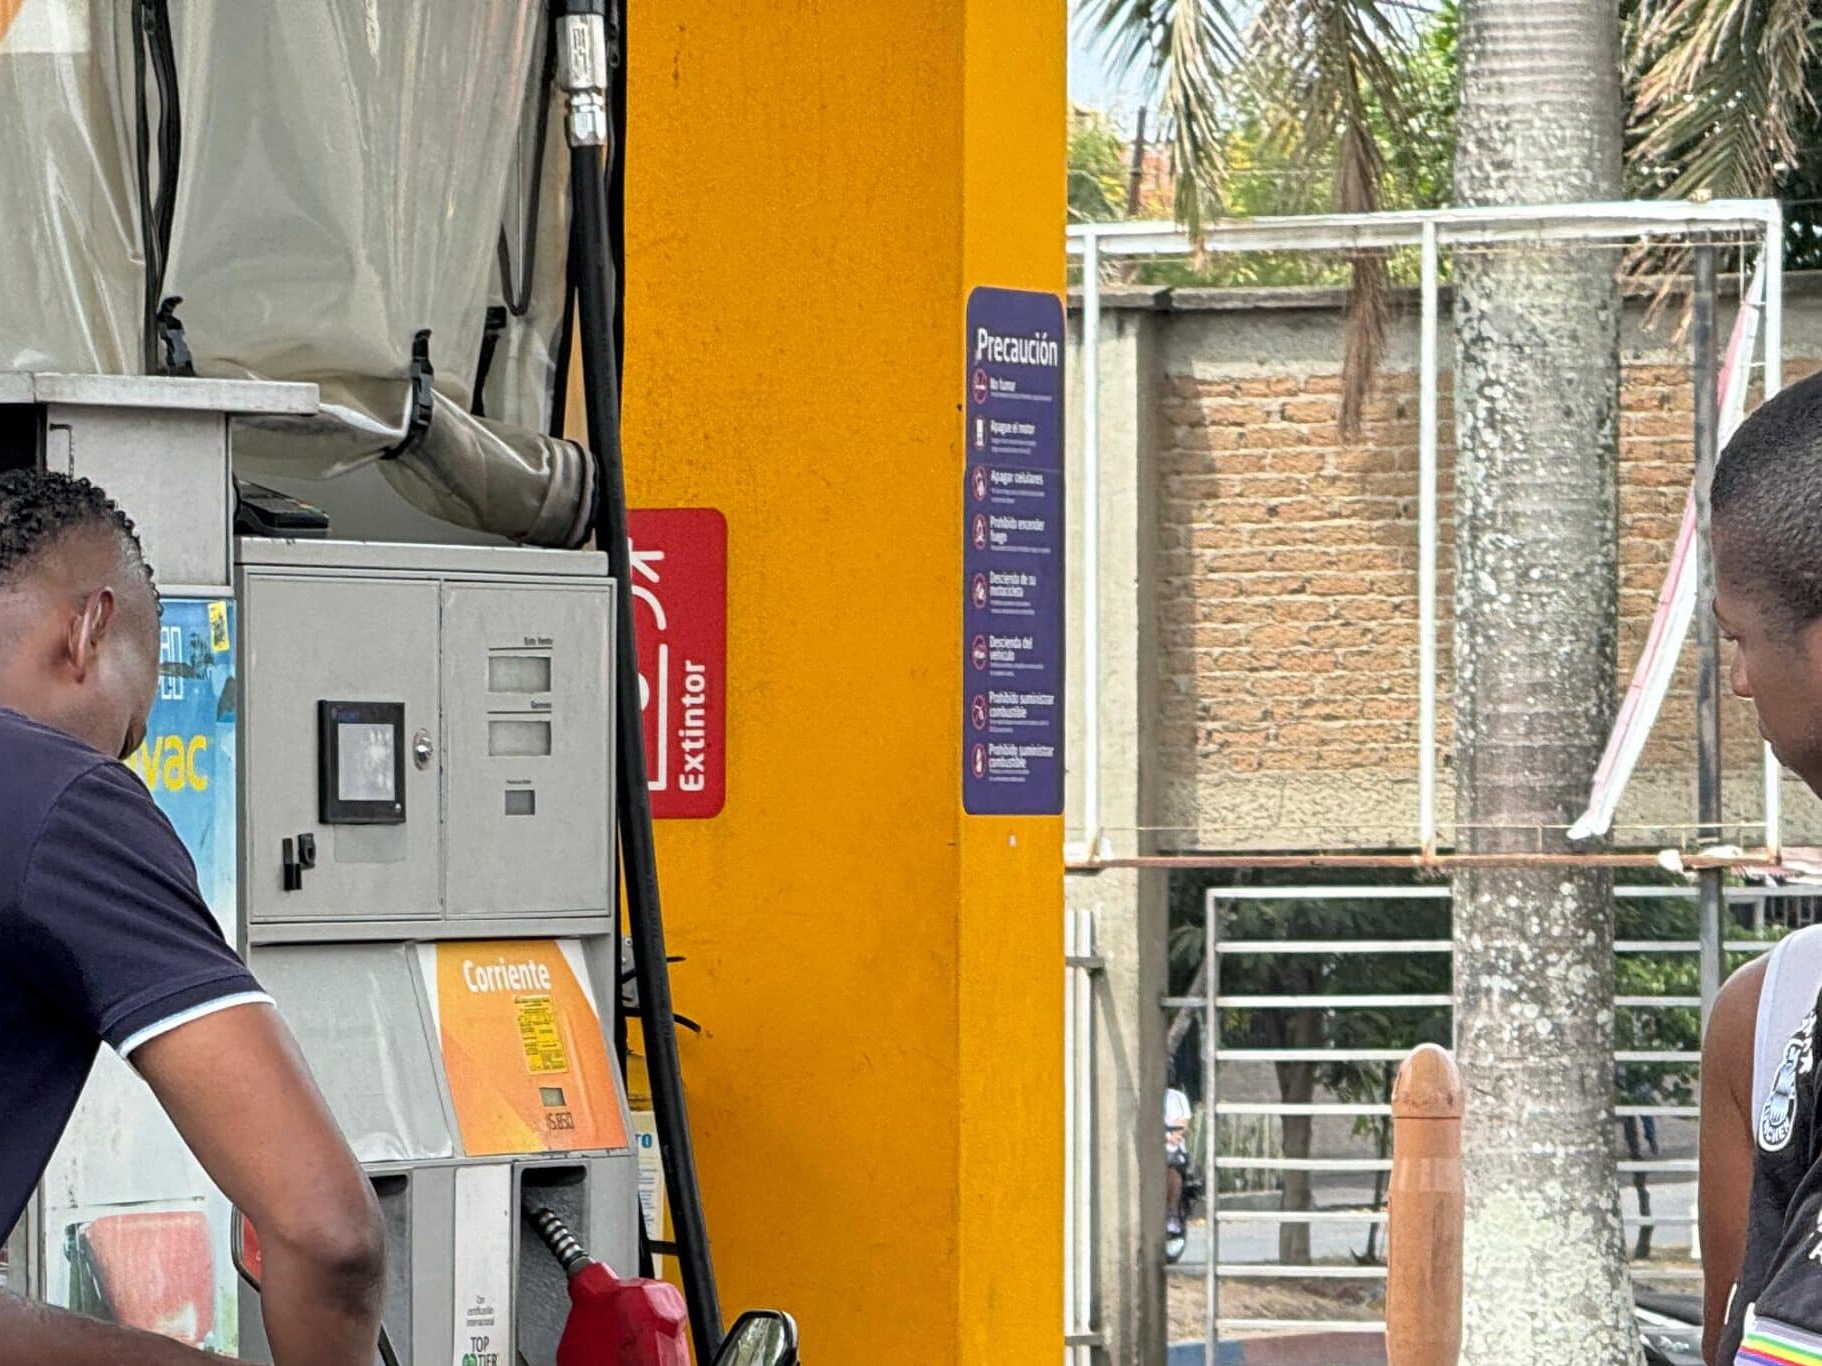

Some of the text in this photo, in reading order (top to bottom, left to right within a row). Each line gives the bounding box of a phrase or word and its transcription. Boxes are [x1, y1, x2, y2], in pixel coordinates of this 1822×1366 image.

[977, 327, 1058, 367] Precaución
[678, 659, 706, 791] Extintor
[463, 956, 552, 993] Corriente
[470, 1335, 490, 1353] TOP
